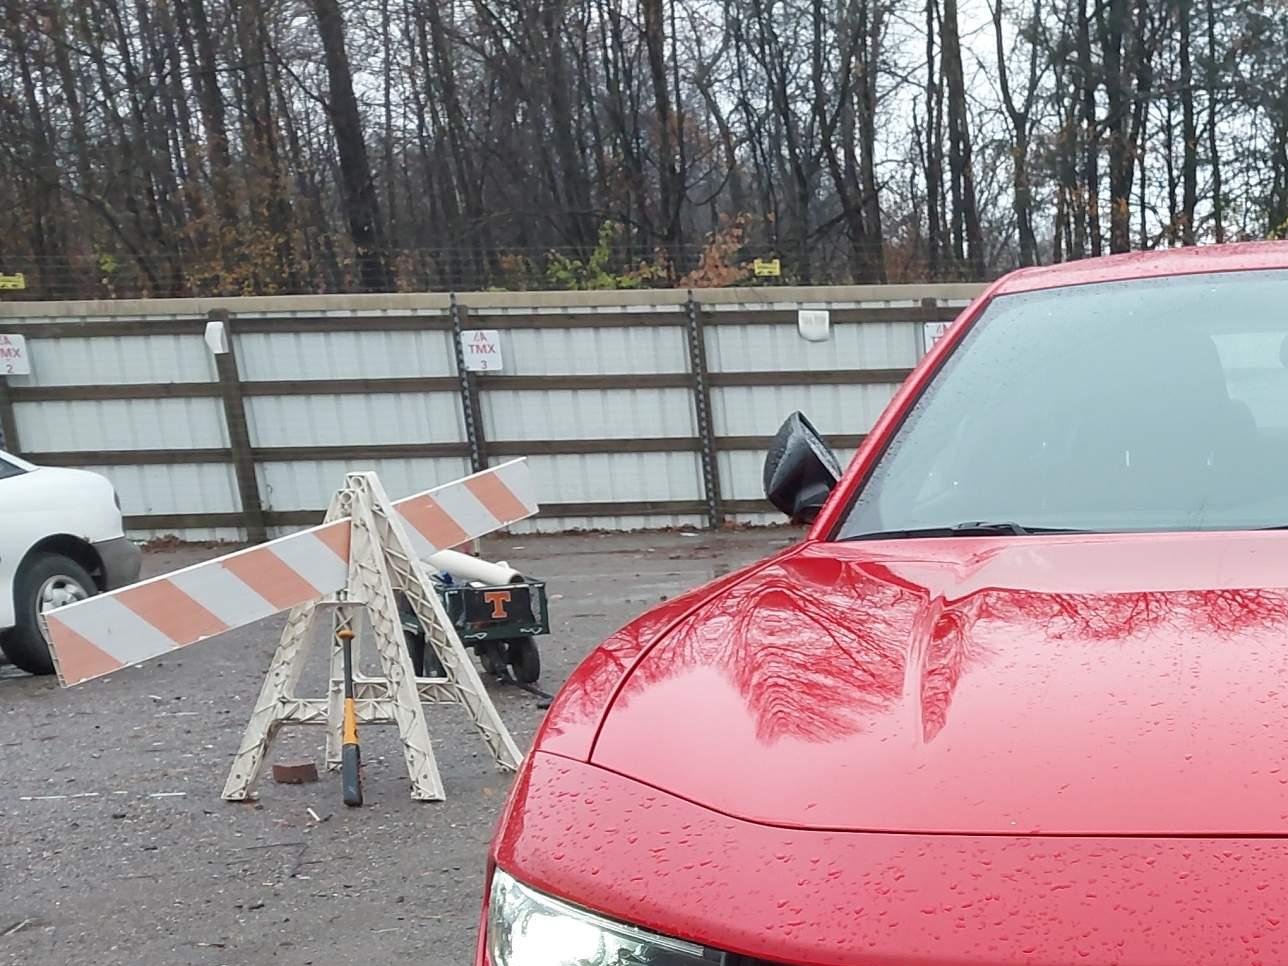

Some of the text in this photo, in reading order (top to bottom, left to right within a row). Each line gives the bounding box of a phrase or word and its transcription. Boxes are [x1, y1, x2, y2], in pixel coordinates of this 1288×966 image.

[0, 348, 21, 358] MX
[468, 344, 496, 354] TMX
[6, 364, 15, 374] 2
[480, 359, 488, 370] 3
[484, 591, 512, 619] T
